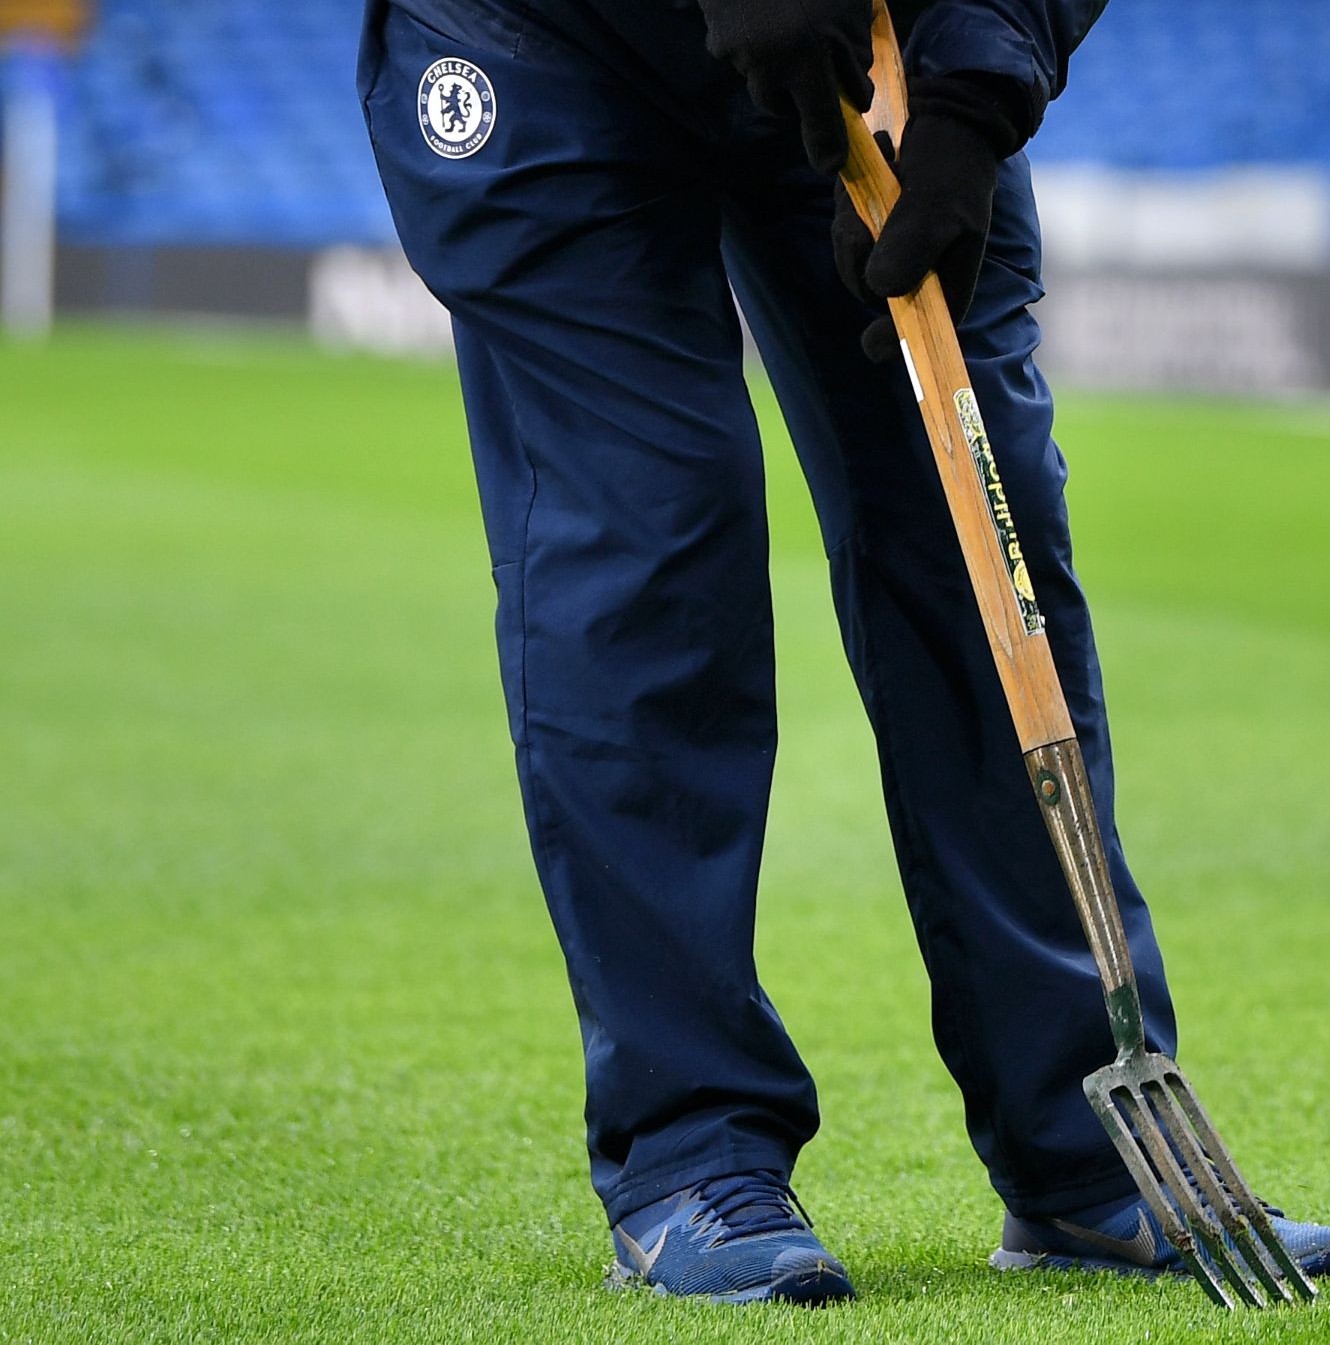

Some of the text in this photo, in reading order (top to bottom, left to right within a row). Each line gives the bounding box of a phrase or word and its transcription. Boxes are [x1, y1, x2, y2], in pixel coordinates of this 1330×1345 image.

[427, 62, 478, 84] CHELSEA
[430, 133, 483, 153] FOOTBALL CLUB
